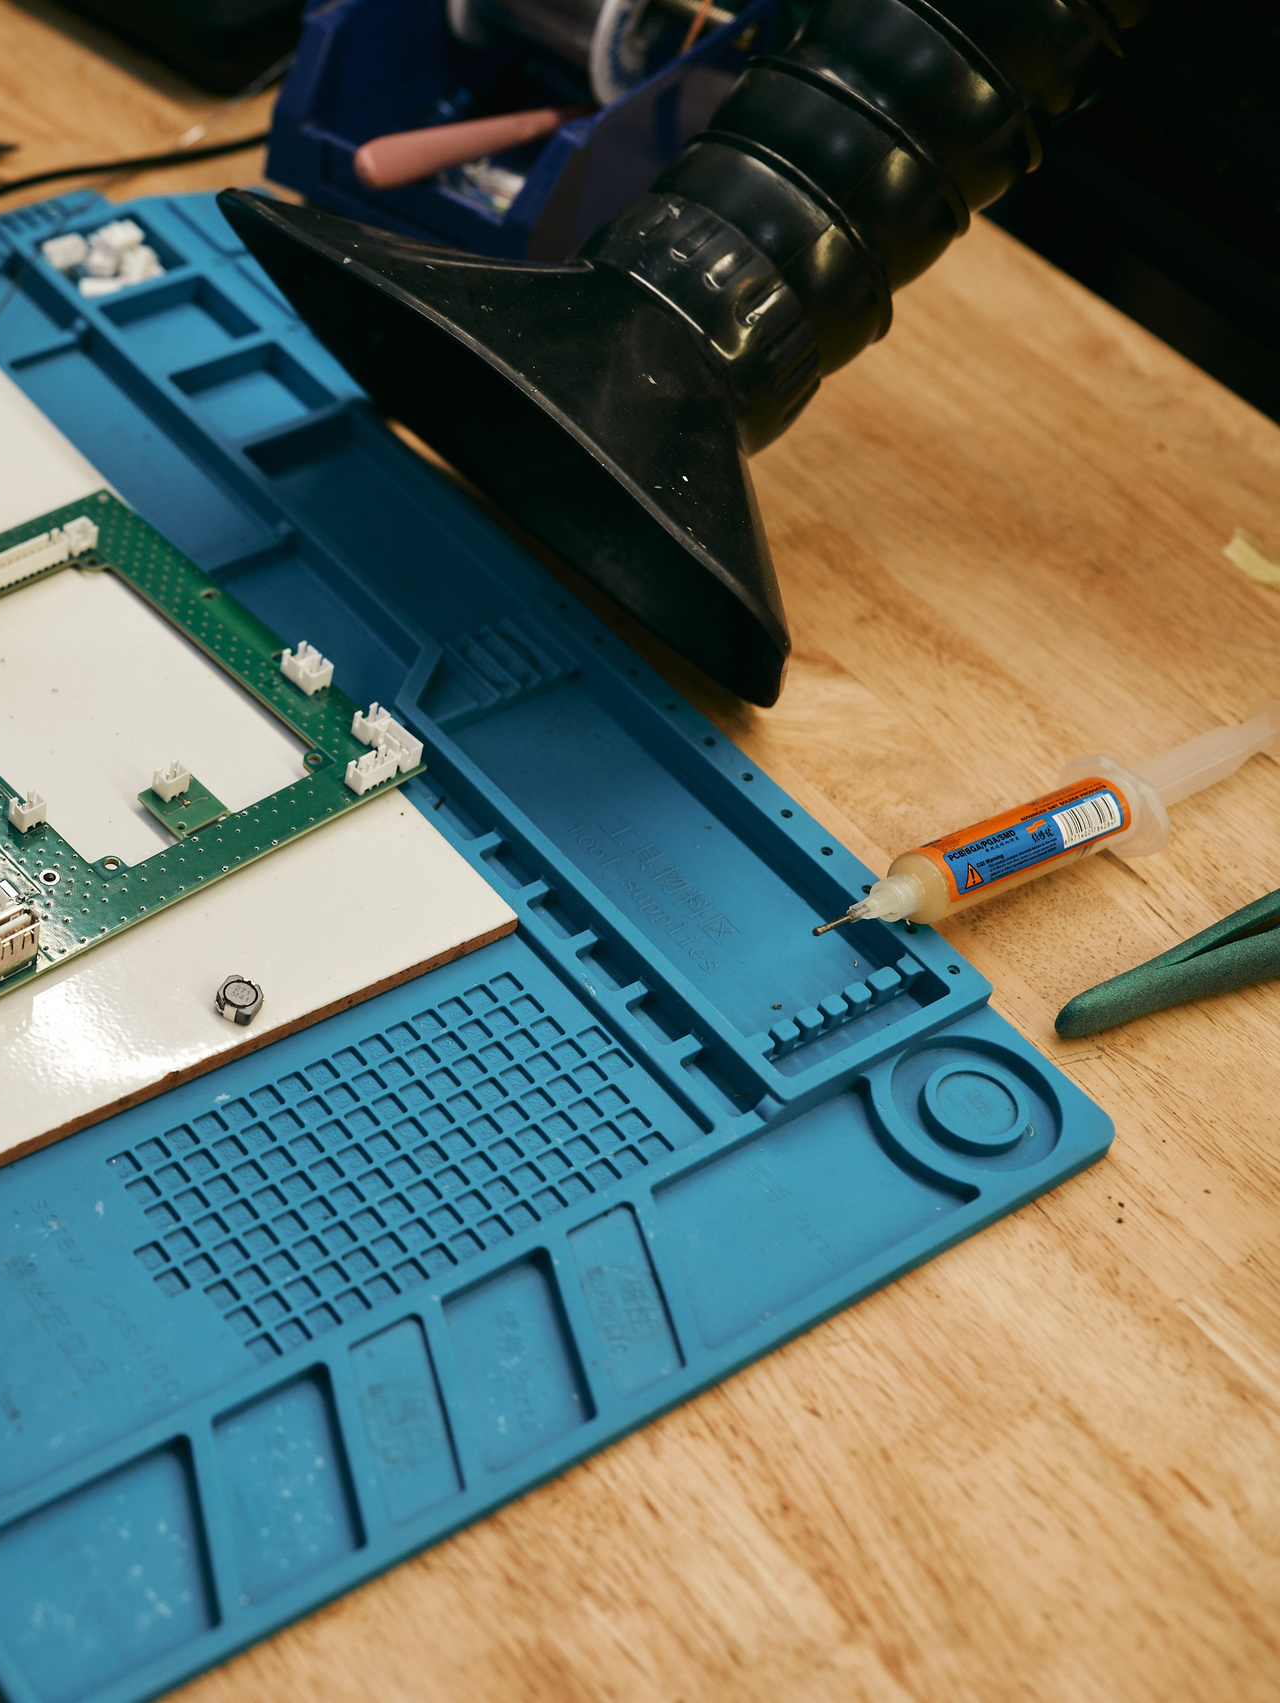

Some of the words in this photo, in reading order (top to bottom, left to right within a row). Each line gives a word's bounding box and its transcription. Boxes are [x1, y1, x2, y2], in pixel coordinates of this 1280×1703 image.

[985, 853, 1004, 865] Warning
[234, 985, 251, 996] 271
[31, 1198, 92, 1271] screw
[90, 1291, 181, 1397] position
